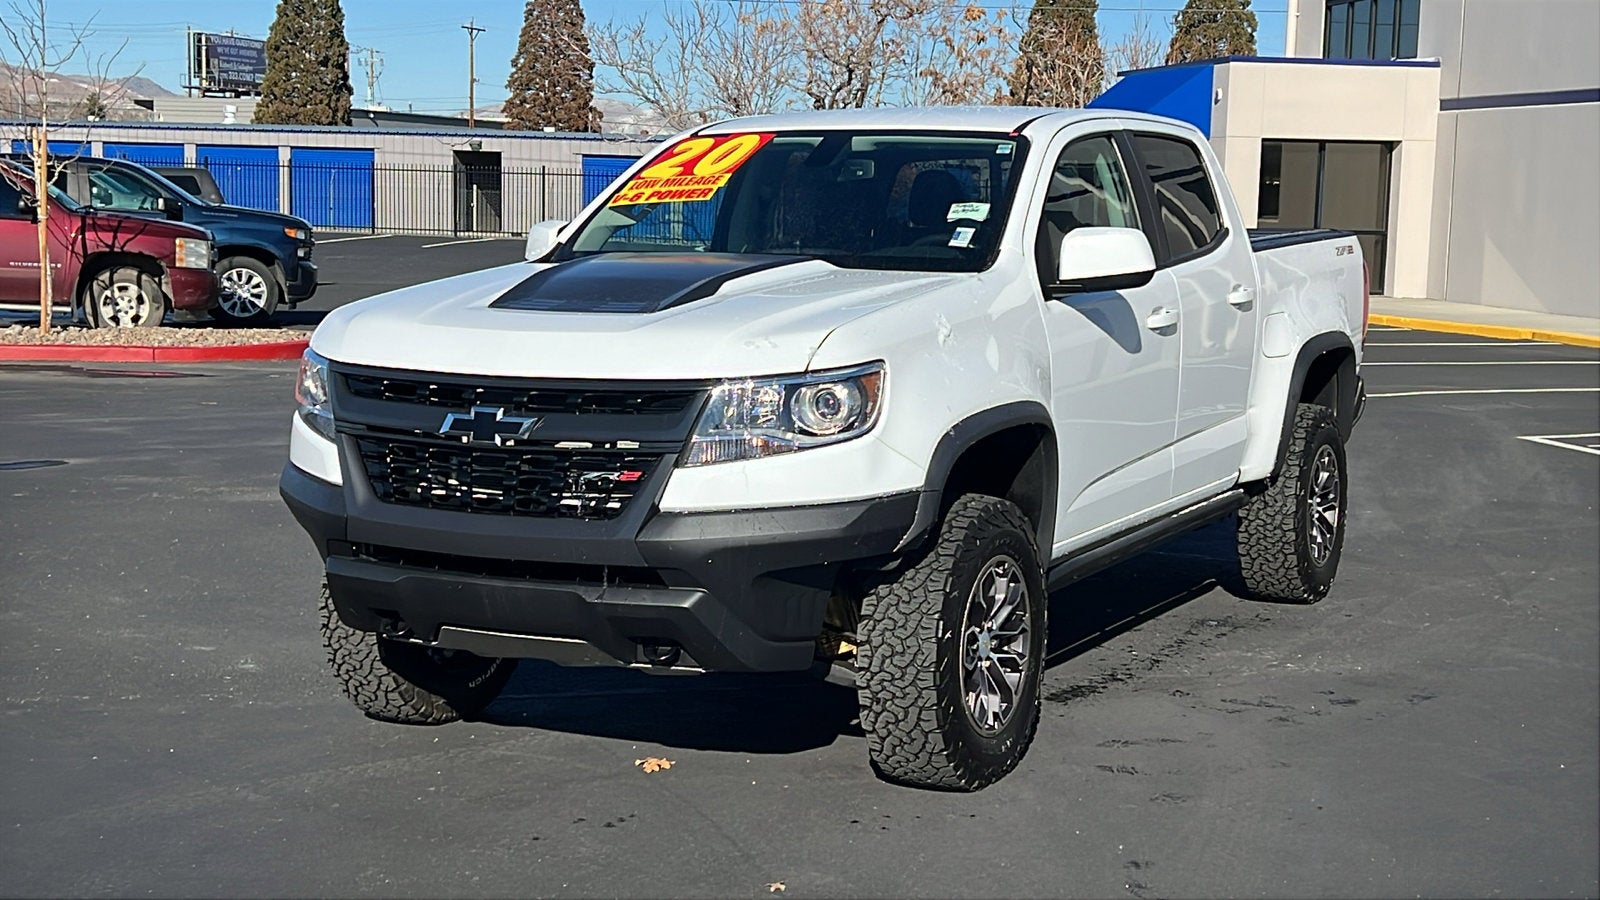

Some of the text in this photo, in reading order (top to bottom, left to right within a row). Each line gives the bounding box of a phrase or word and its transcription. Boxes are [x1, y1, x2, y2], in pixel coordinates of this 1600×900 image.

[210, 36, 221, 44] YOU
[222, 37, 235, 46] HAVE
[640, 134, 761, 178] 20
[629, 174, 723, 191] LOW MILEAGE
[611, 187, 714, 204] V-6 POWER
